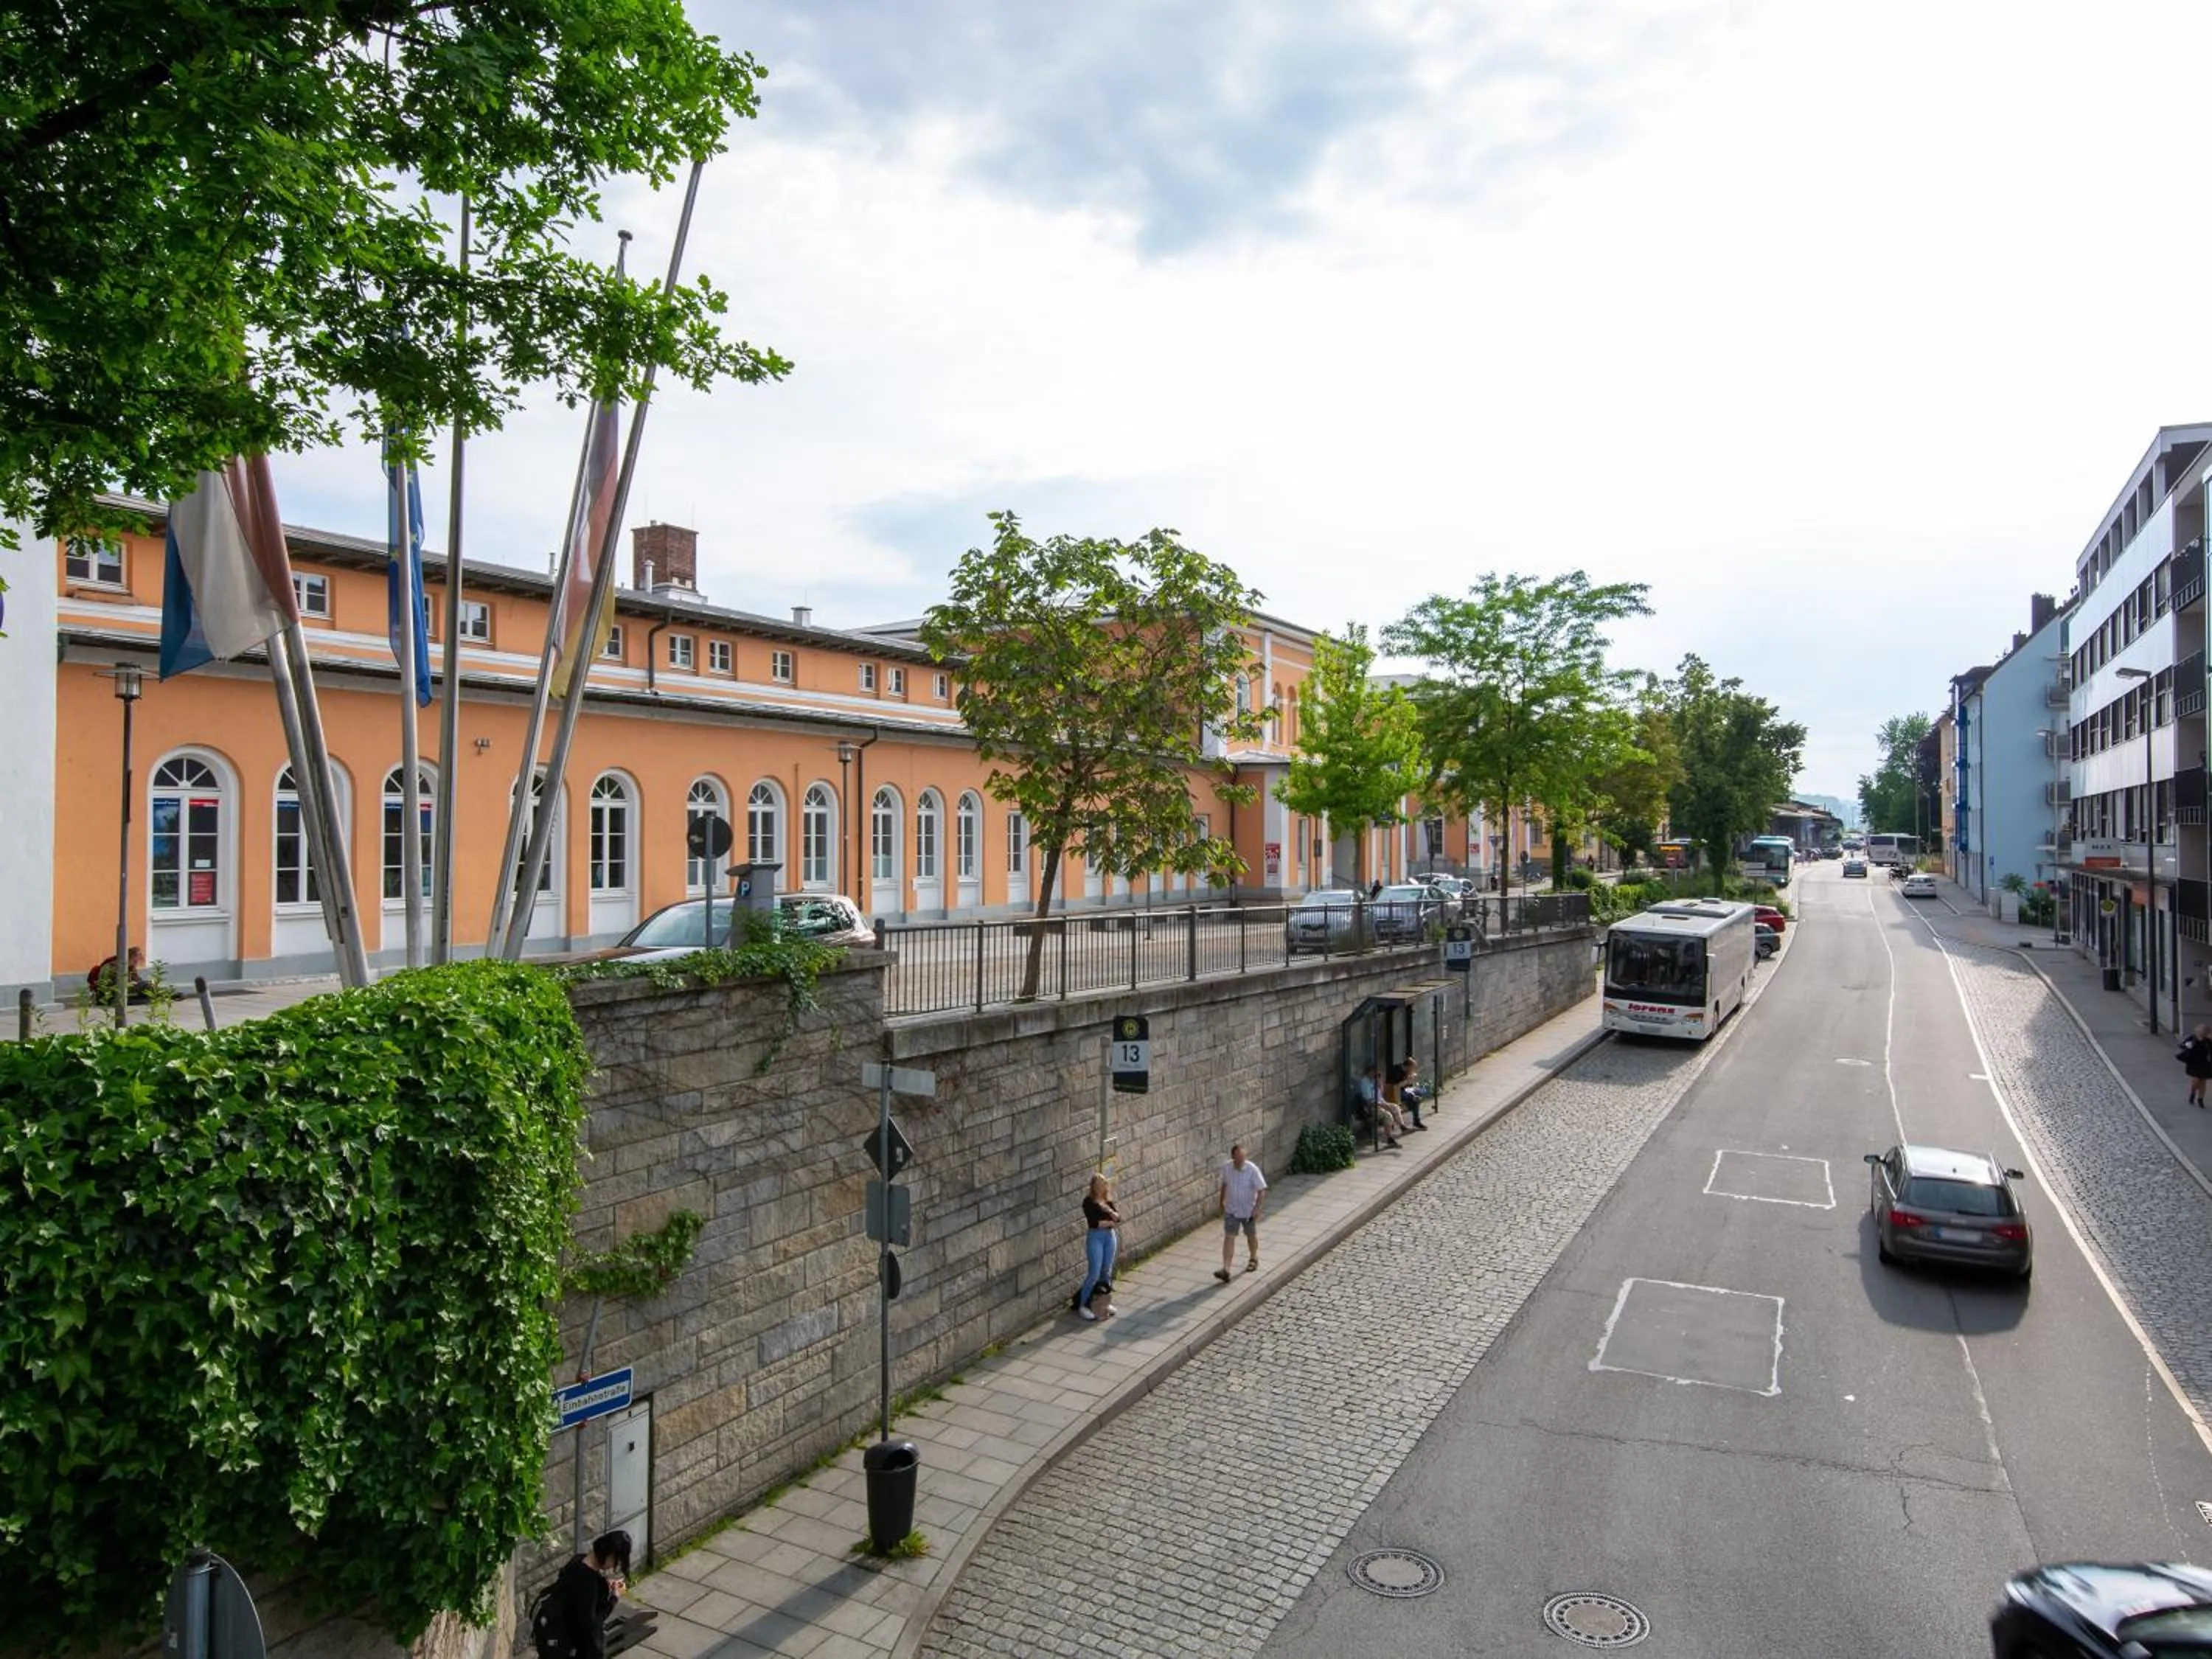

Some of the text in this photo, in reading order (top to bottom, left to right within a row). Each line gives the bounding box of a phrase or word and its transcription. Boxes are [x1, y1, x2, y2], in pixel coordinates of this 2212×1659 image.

[741, 880, 750, 897] P
[1453, 943, 1466, 954] 13
[1121, 1043, 1140, 1062] 13
